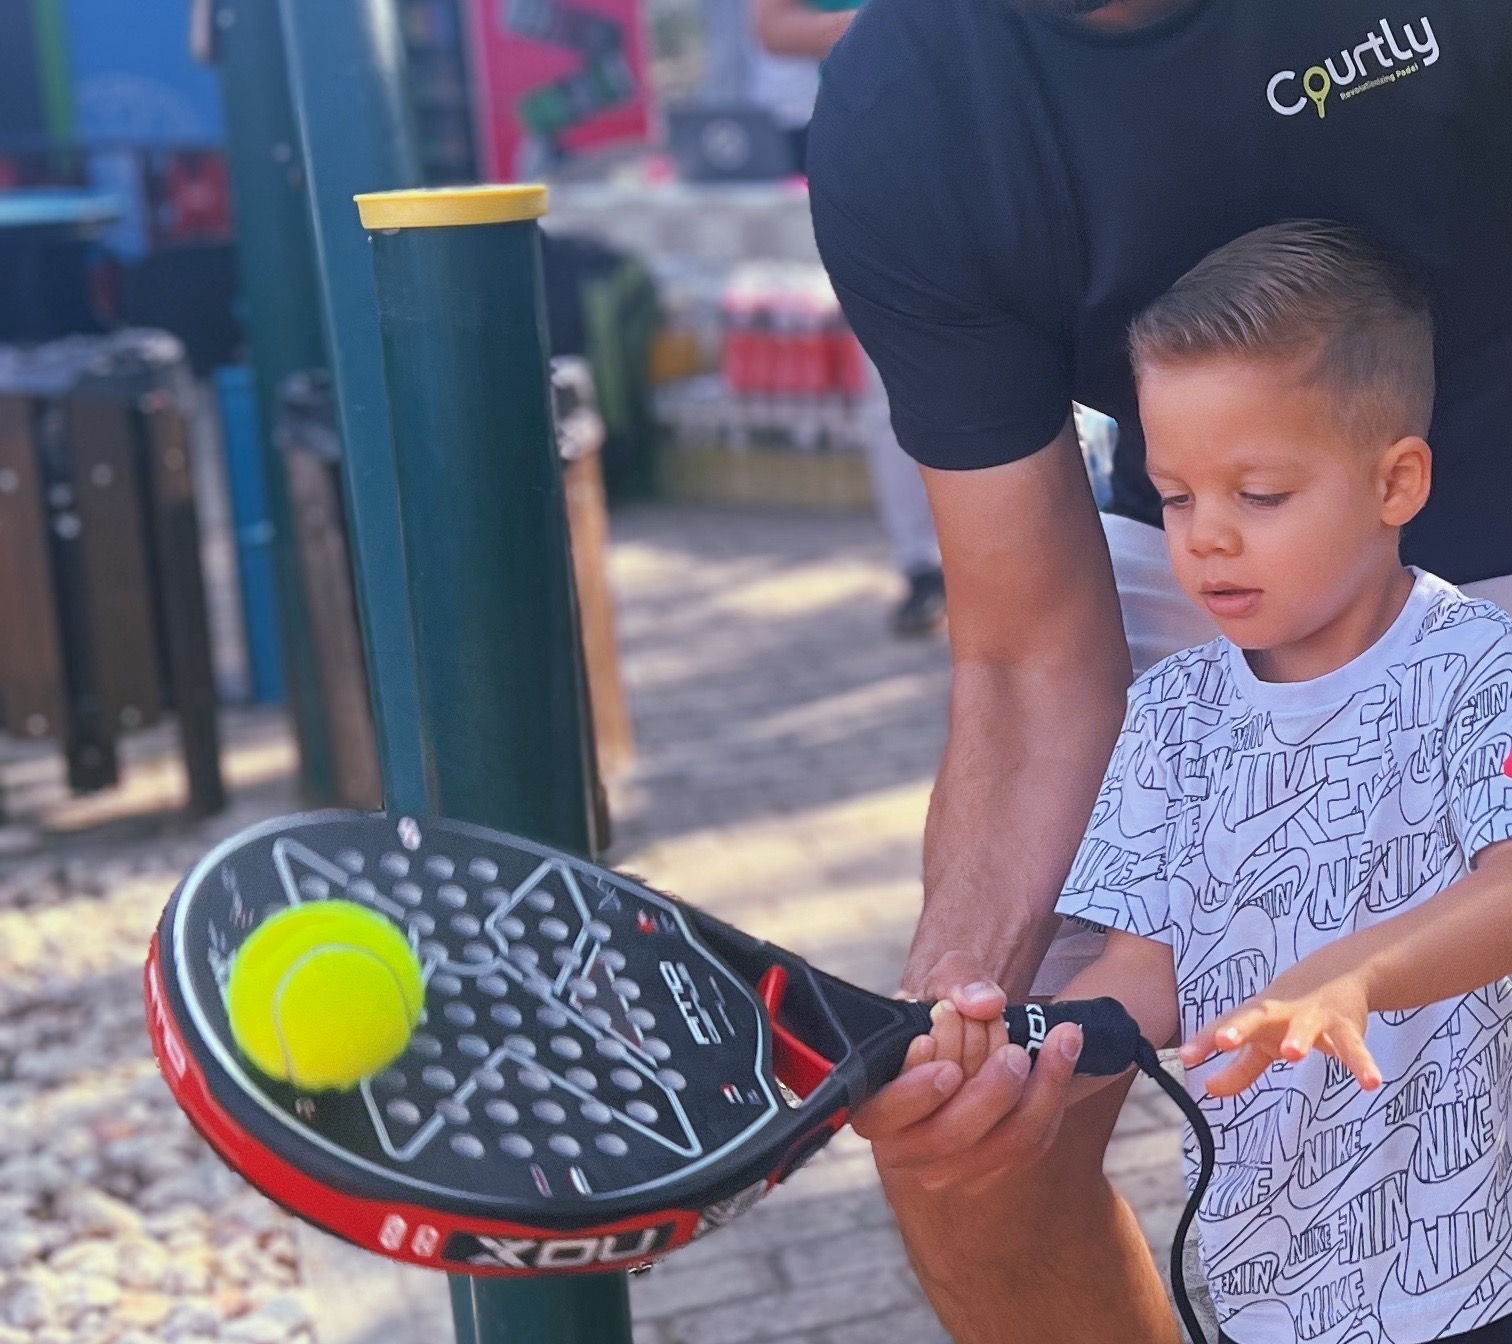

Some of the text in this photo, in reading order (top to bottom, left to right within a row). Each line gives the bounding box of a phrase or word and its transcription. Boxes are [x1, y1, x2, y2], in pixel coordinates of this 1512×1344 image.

[1266, 16, 1440, 119] Courtly
[1302, 1118, 1363, 1189] NIKE
[1417, 1093, 1496, 1183] NIKE
[1289, 1223, 1332, 1266] NIKE
[1300, 1268, 1366, 1341] NIKE
